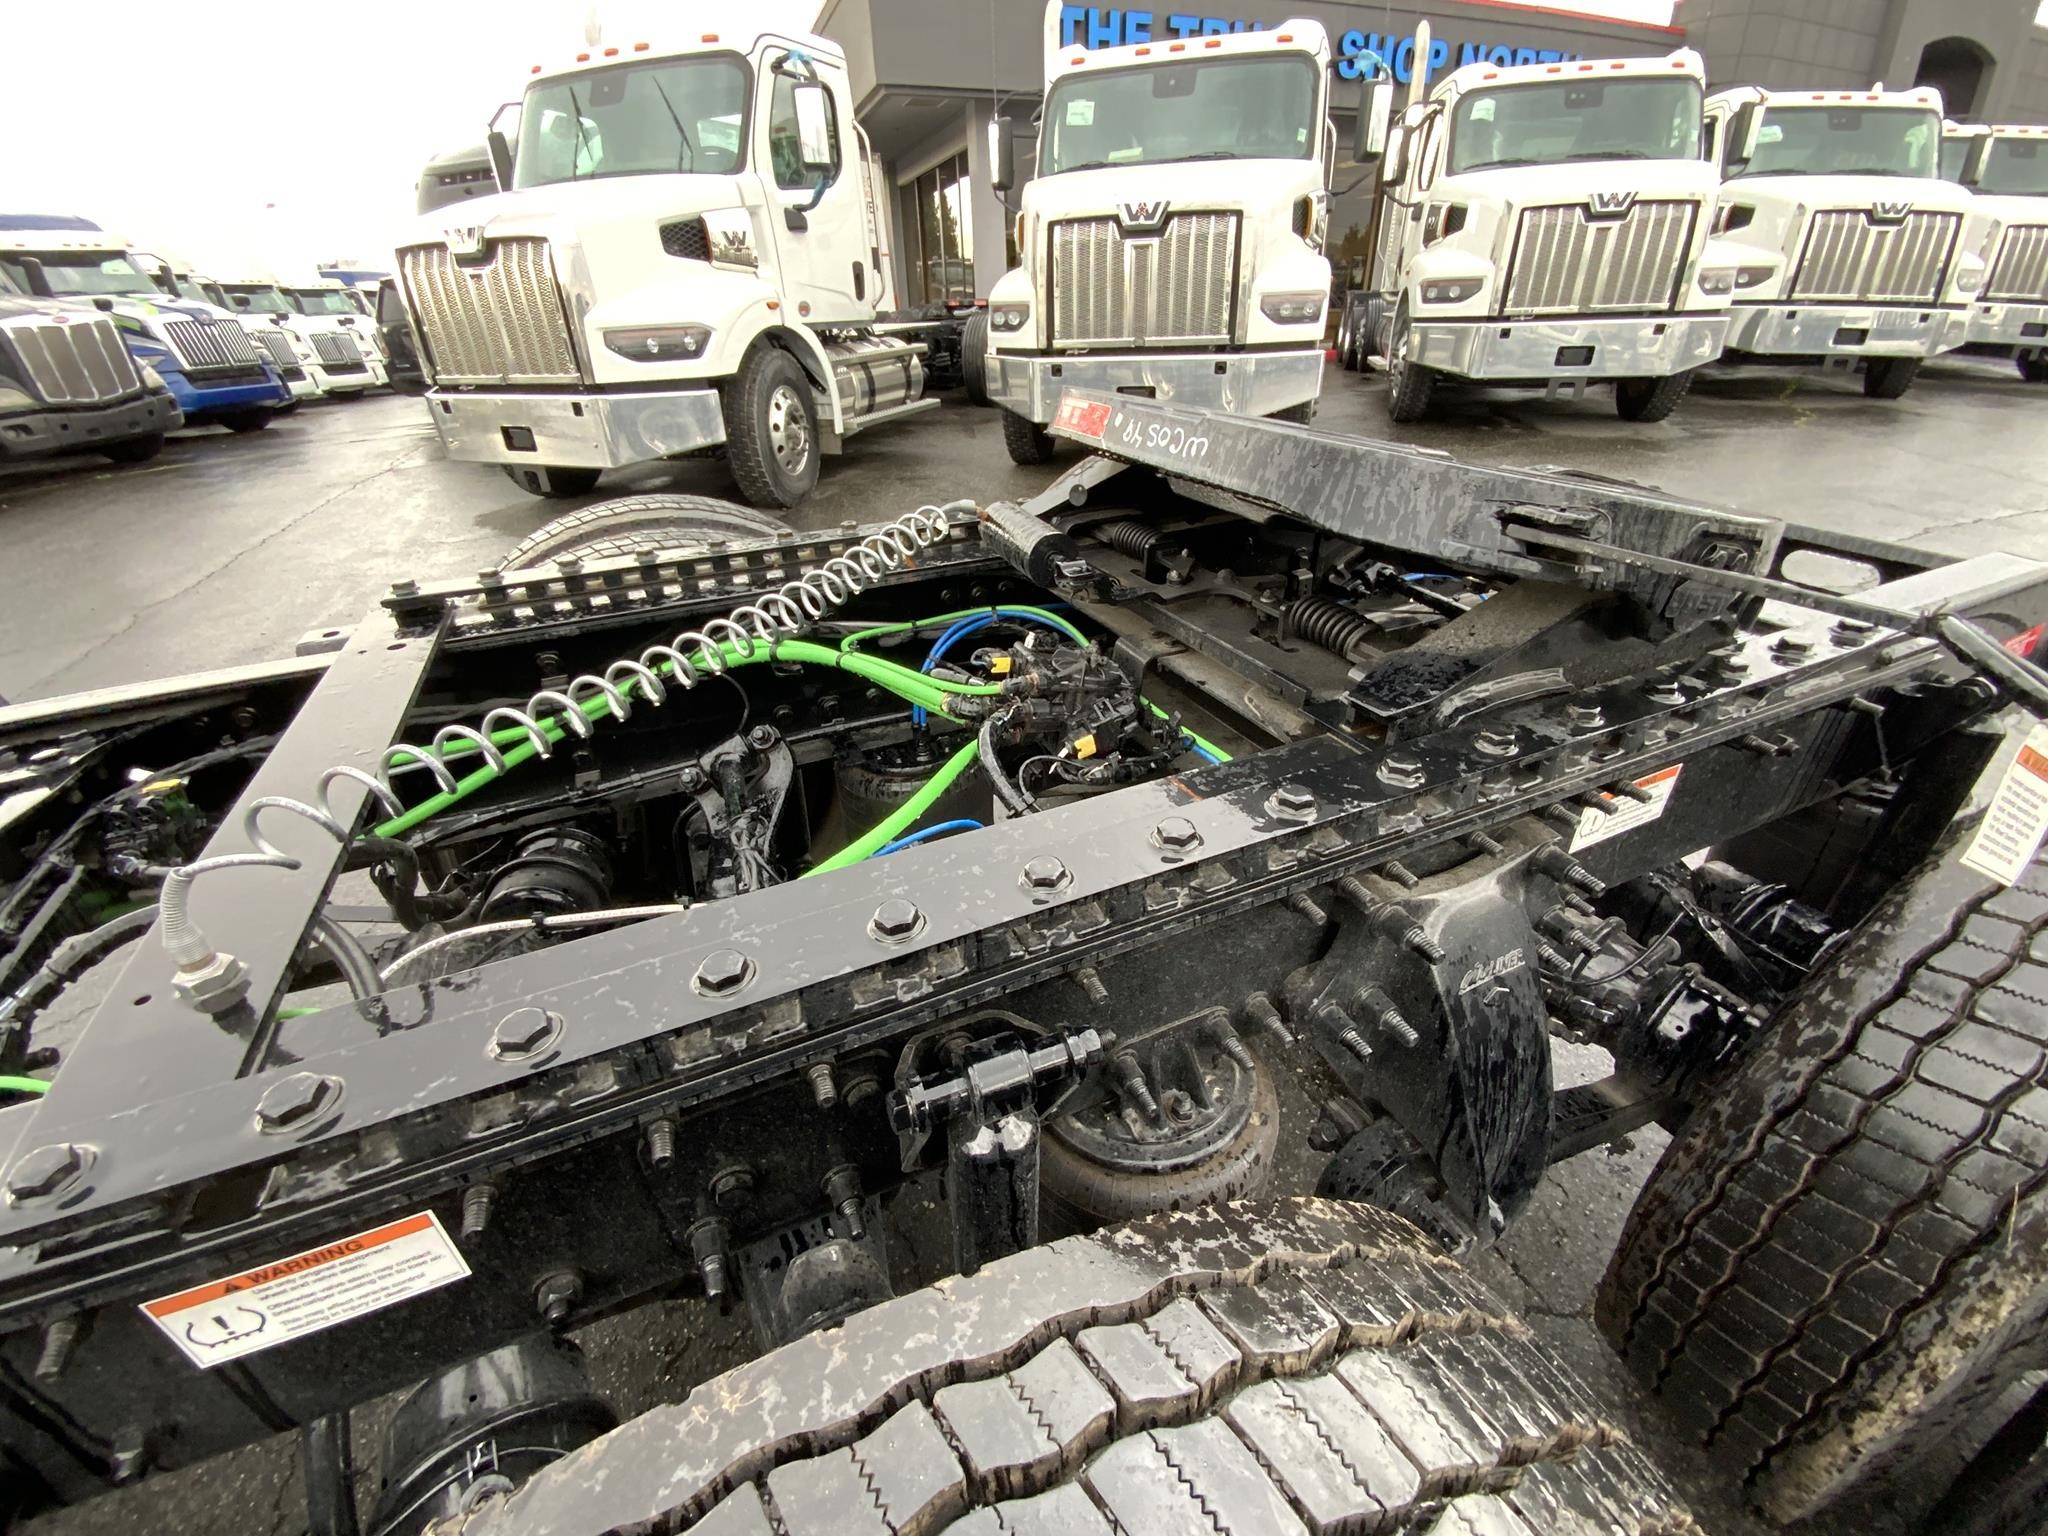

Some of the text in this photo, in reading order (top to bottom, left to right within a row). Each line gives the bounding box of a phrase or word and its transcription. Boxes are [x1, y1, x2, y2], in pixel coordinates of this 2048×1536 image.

[1060, 5, 1153, 50] THE
[1338, 29, 1449, 84] SHOP
[246, 1239, 363, 1284] WARNING
